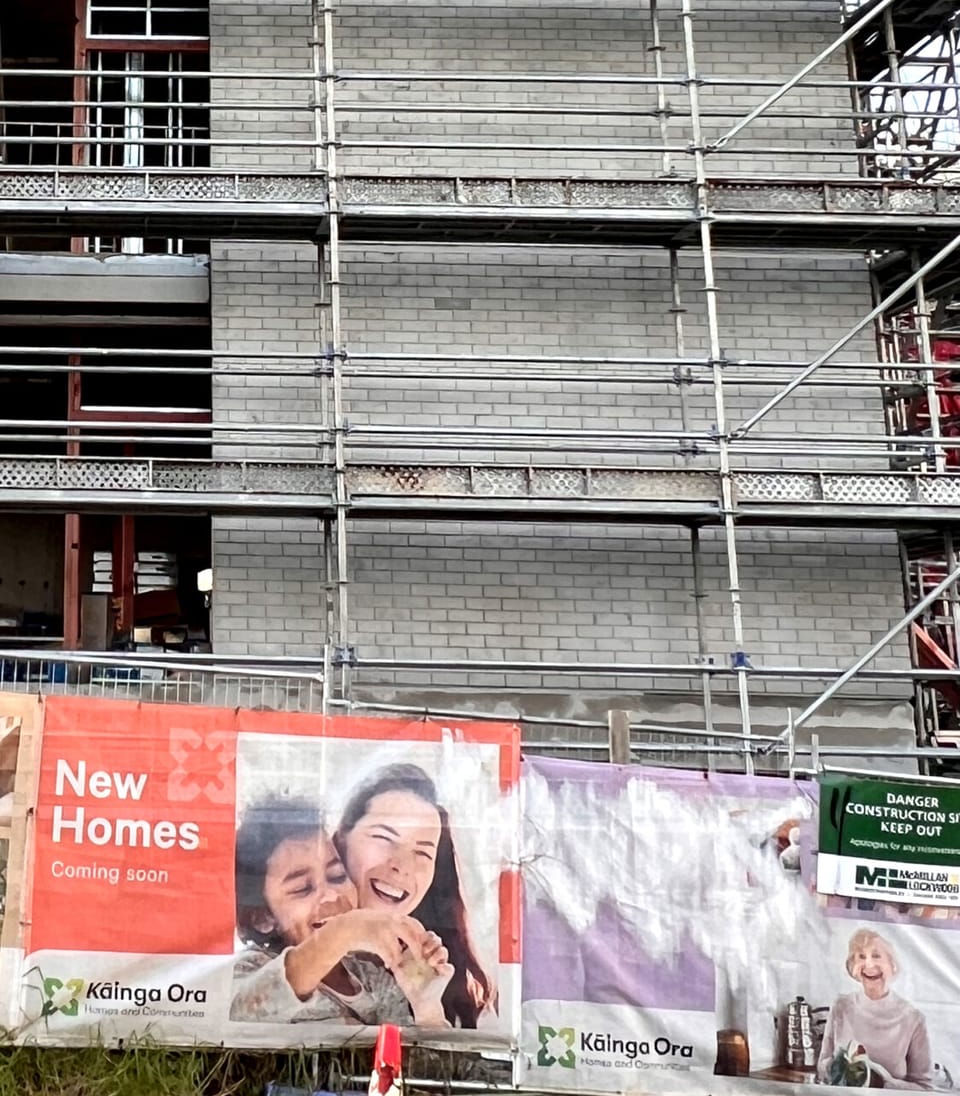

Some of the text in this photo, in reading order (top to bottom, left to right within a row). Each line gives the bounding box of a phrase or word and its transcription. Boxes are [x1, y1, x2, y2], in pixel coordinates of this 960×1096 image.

[55, 758, 148, 801] New
[886, 792, 939, 808] DANGER
[845, 802, 960, 824] CONSTRUCTION SI
[52, 805, 200, 850] Homes
[881, 821, 943, 837] KEEP OUT
[51, 861, 168, 885] Coming soon
[86, 981, 207, 1006] Kāinga Ora
[120, 1006, 140, 1016] and
[580, 1032, 694, 1059] Kāinga Ora
[614, 1060, 633, 1069] and
